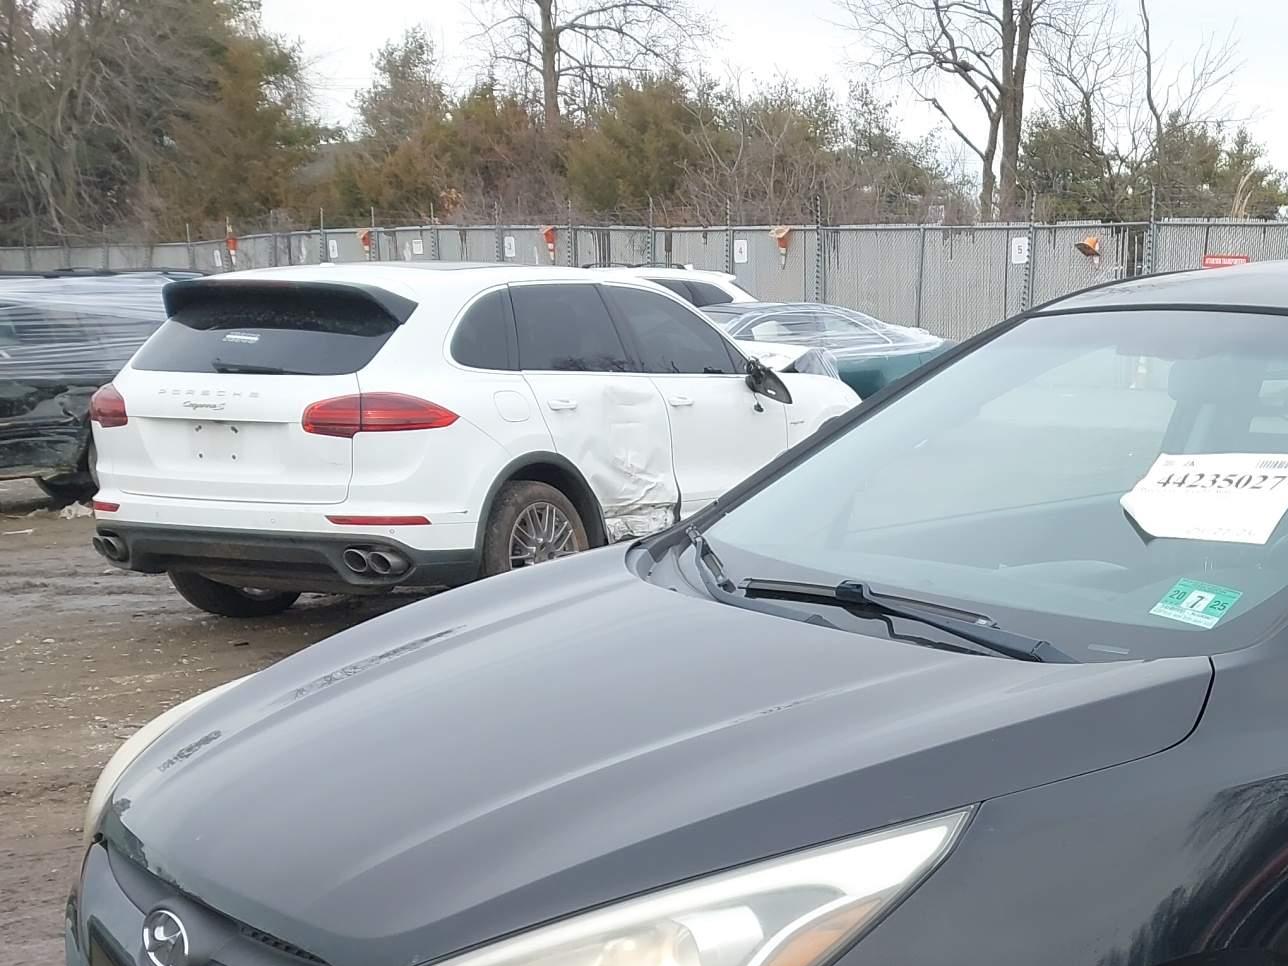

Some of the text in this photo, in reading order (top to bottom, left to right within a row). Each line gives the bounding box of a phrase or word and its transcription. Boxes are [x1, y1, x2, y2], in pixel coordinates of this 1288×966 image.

[1016, 243, 1023, 255] 5
[158, 388, 260, 399] PORSCHE
[1156, 473, 1288, 491] 44235027
[1169, 589, 1229, 612] 20 7 25
